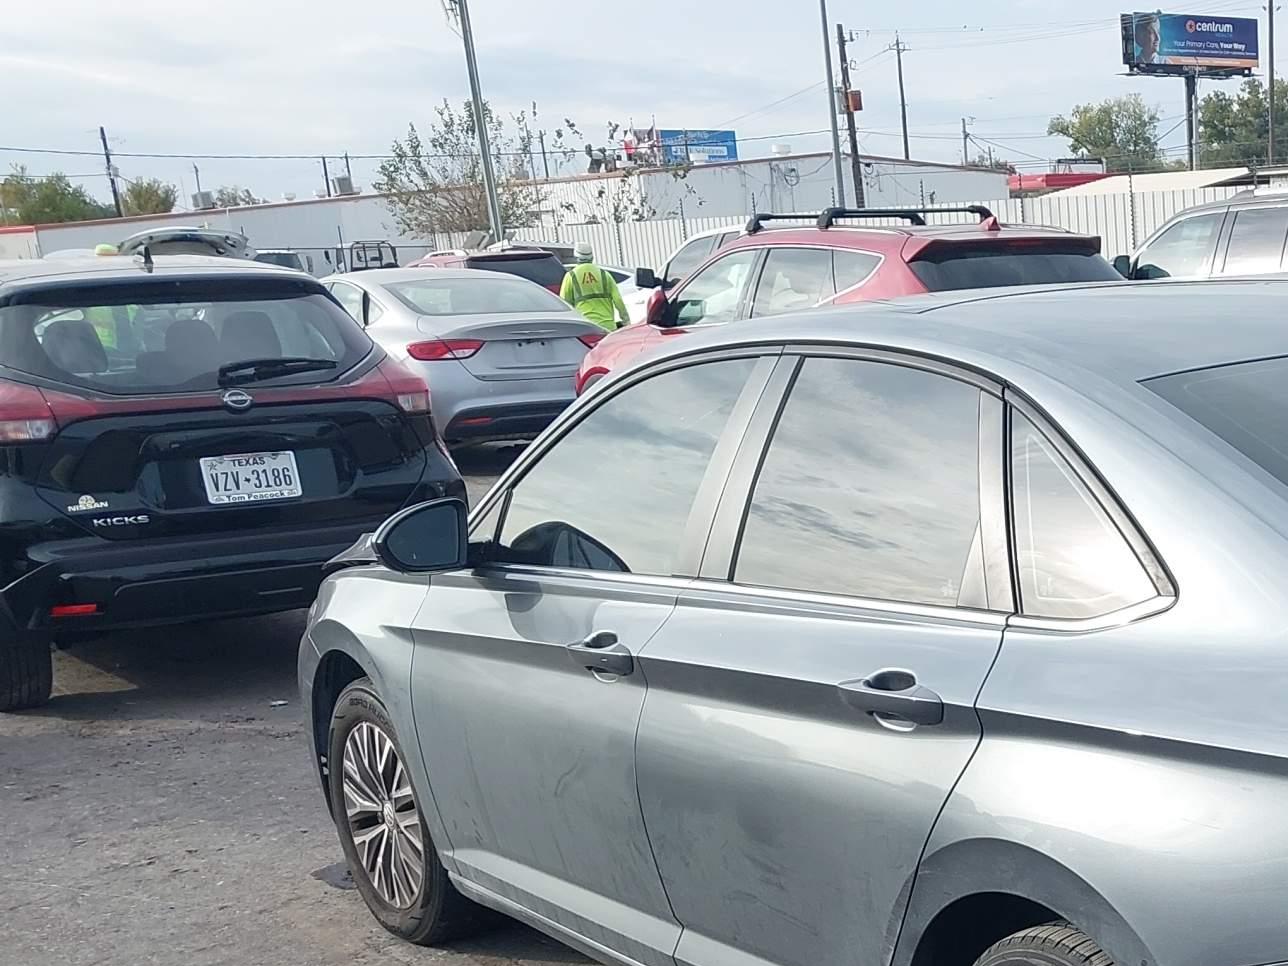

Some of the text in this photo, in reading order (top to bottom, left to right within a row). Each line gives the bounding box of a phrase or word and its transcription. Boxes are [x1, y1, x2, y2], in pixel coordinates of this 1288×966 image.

[1196, 21, 1233, 33] centrum
[232, 456, 266, 467] TEXAS
[226, 491, 286, 502] Tom Peacock
[92, 515, 150, 527] KICKS
